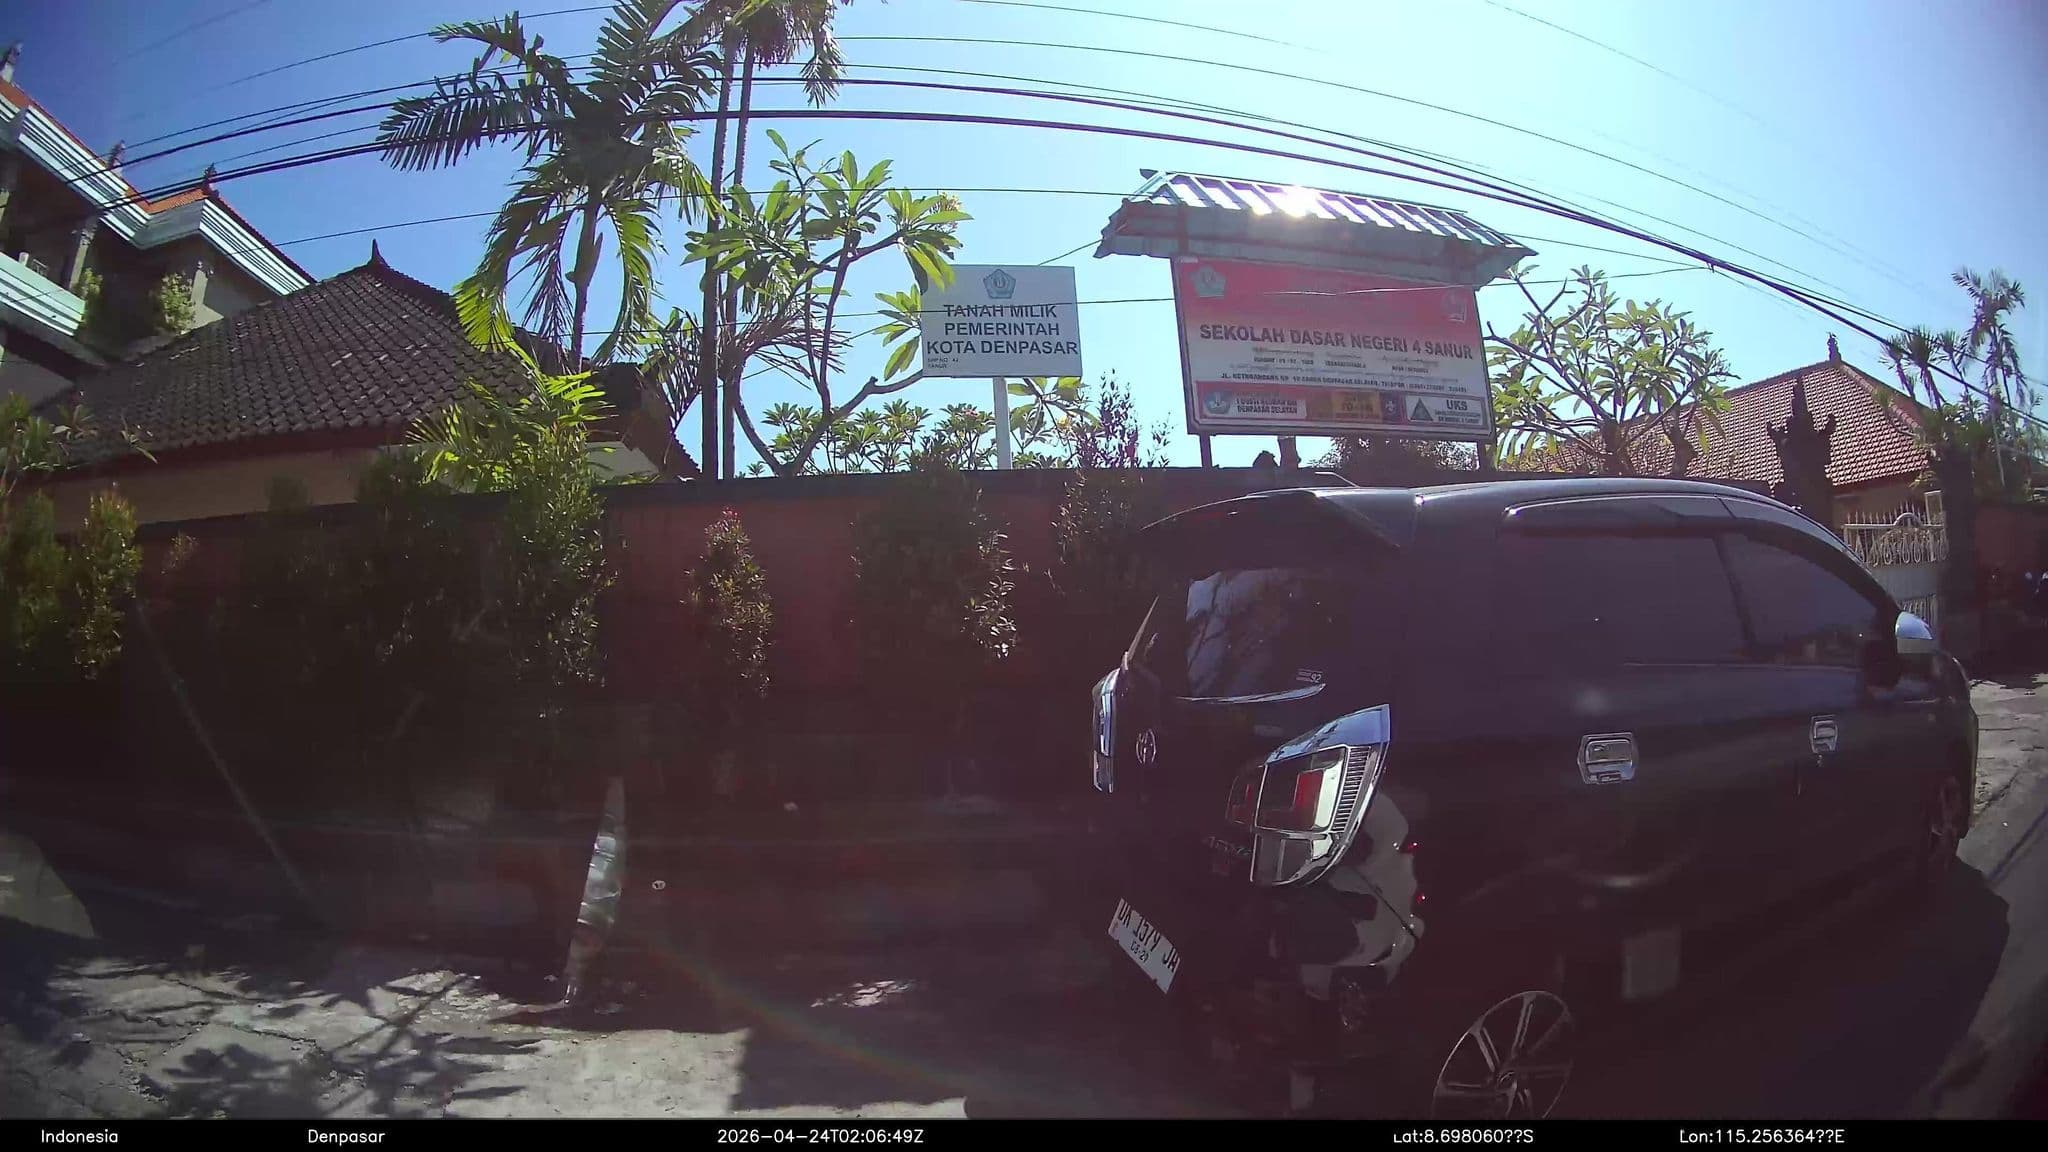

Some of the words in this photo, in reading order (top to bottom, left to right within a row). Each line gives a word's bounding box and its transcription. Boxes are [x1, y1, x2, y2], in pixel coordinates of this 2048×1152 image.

[943, 304, 1004, 318] TANAH
[1010, 304, 1057, 318] MILIK
[944, 322, 1060, 336] PEMERINTAH
[927, 340, 977, 355] KOTA
[980, 340, 1079, 355] DENPASAR
[1199, 324, 1285, 343] SEKOLAH
[1290, 328, 1346, 348] DASAR
[1350, 332, 1408, 352] NEGERI
[1412, 340, 1421, 354] 4
[1424, 341, 1473, 360] SANUR
[1446, 399, 1468, 411] UKS
